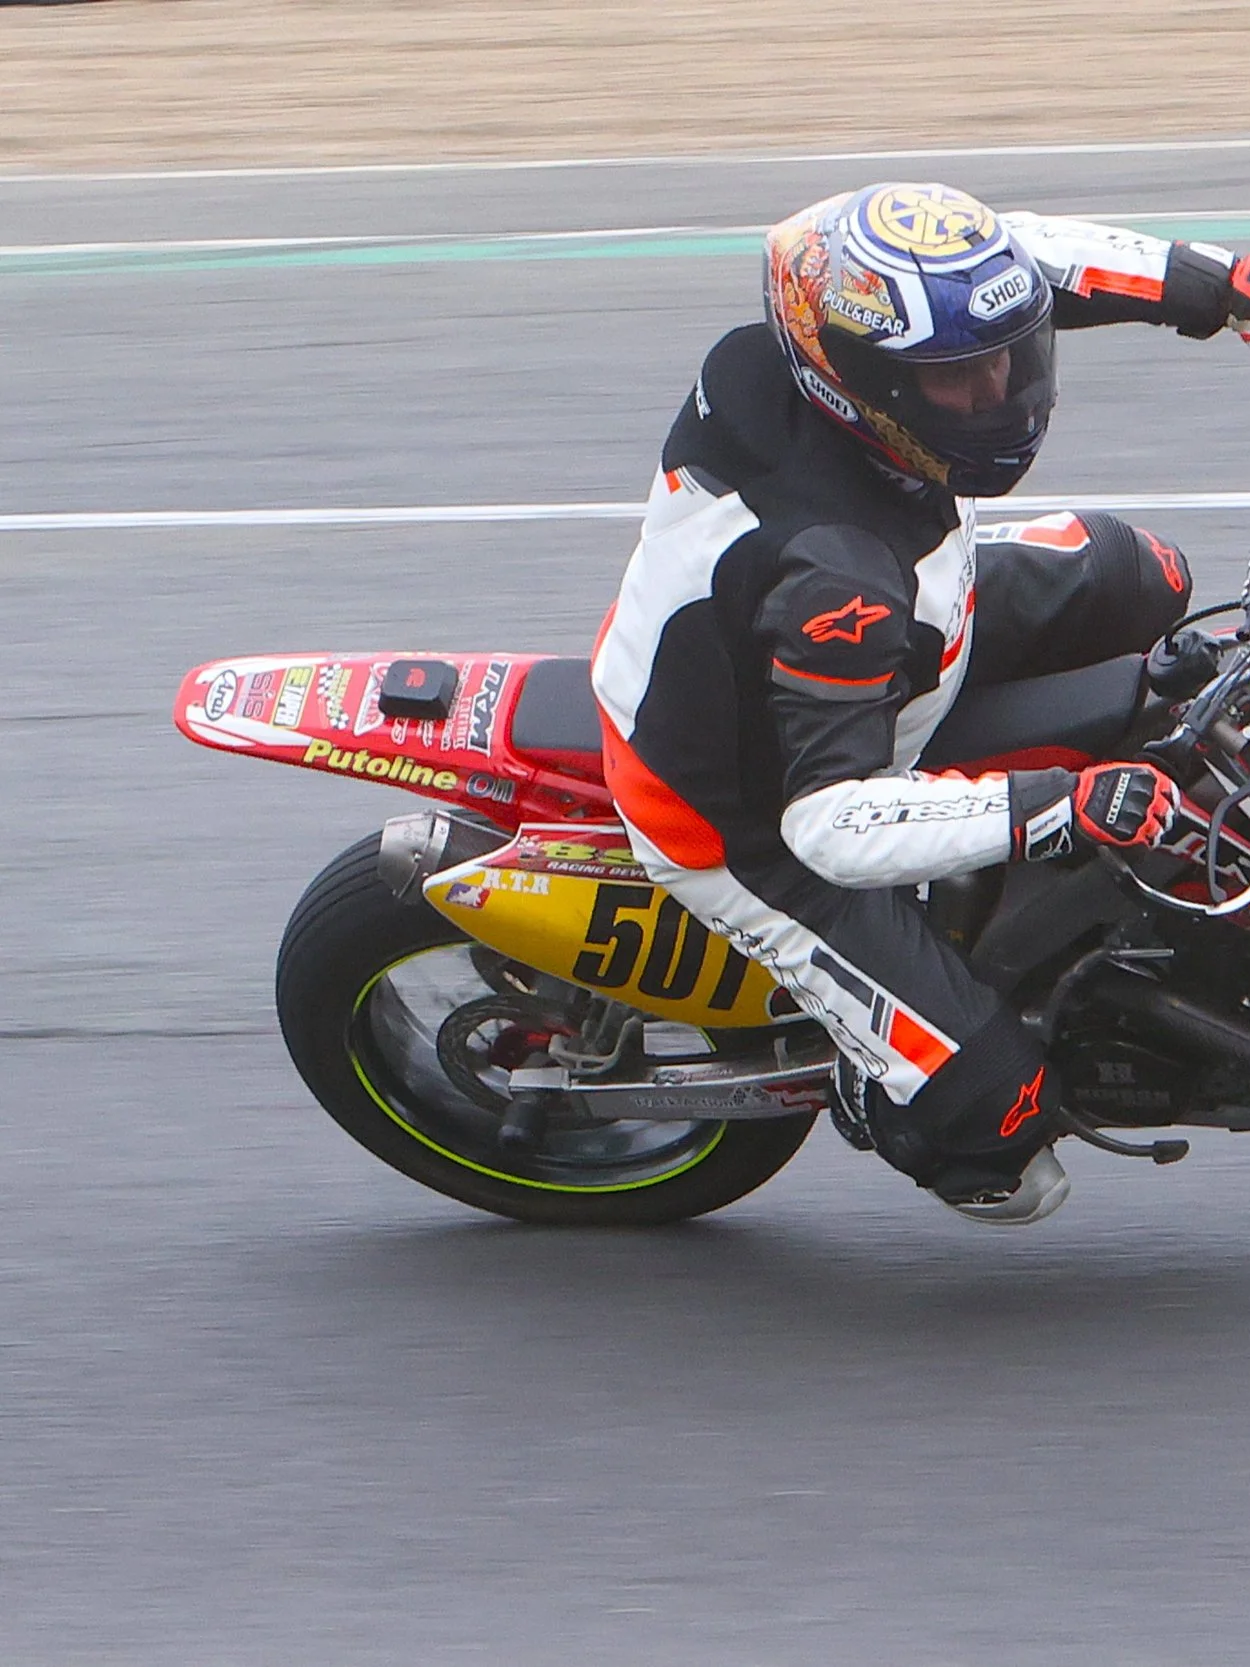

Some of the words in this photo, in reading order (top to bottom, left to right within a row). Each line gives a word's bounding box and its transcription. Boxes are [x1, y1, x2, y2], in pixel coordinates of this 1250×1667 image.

[980, 268, 1027, 312] SHOEI
[823, 290, 905, 338] PULL&BEAR
[809, 371, 850, 417] SHOEI
[303, 738, 459, 791] Putoline
[547, 860, 606, 875] RACING
